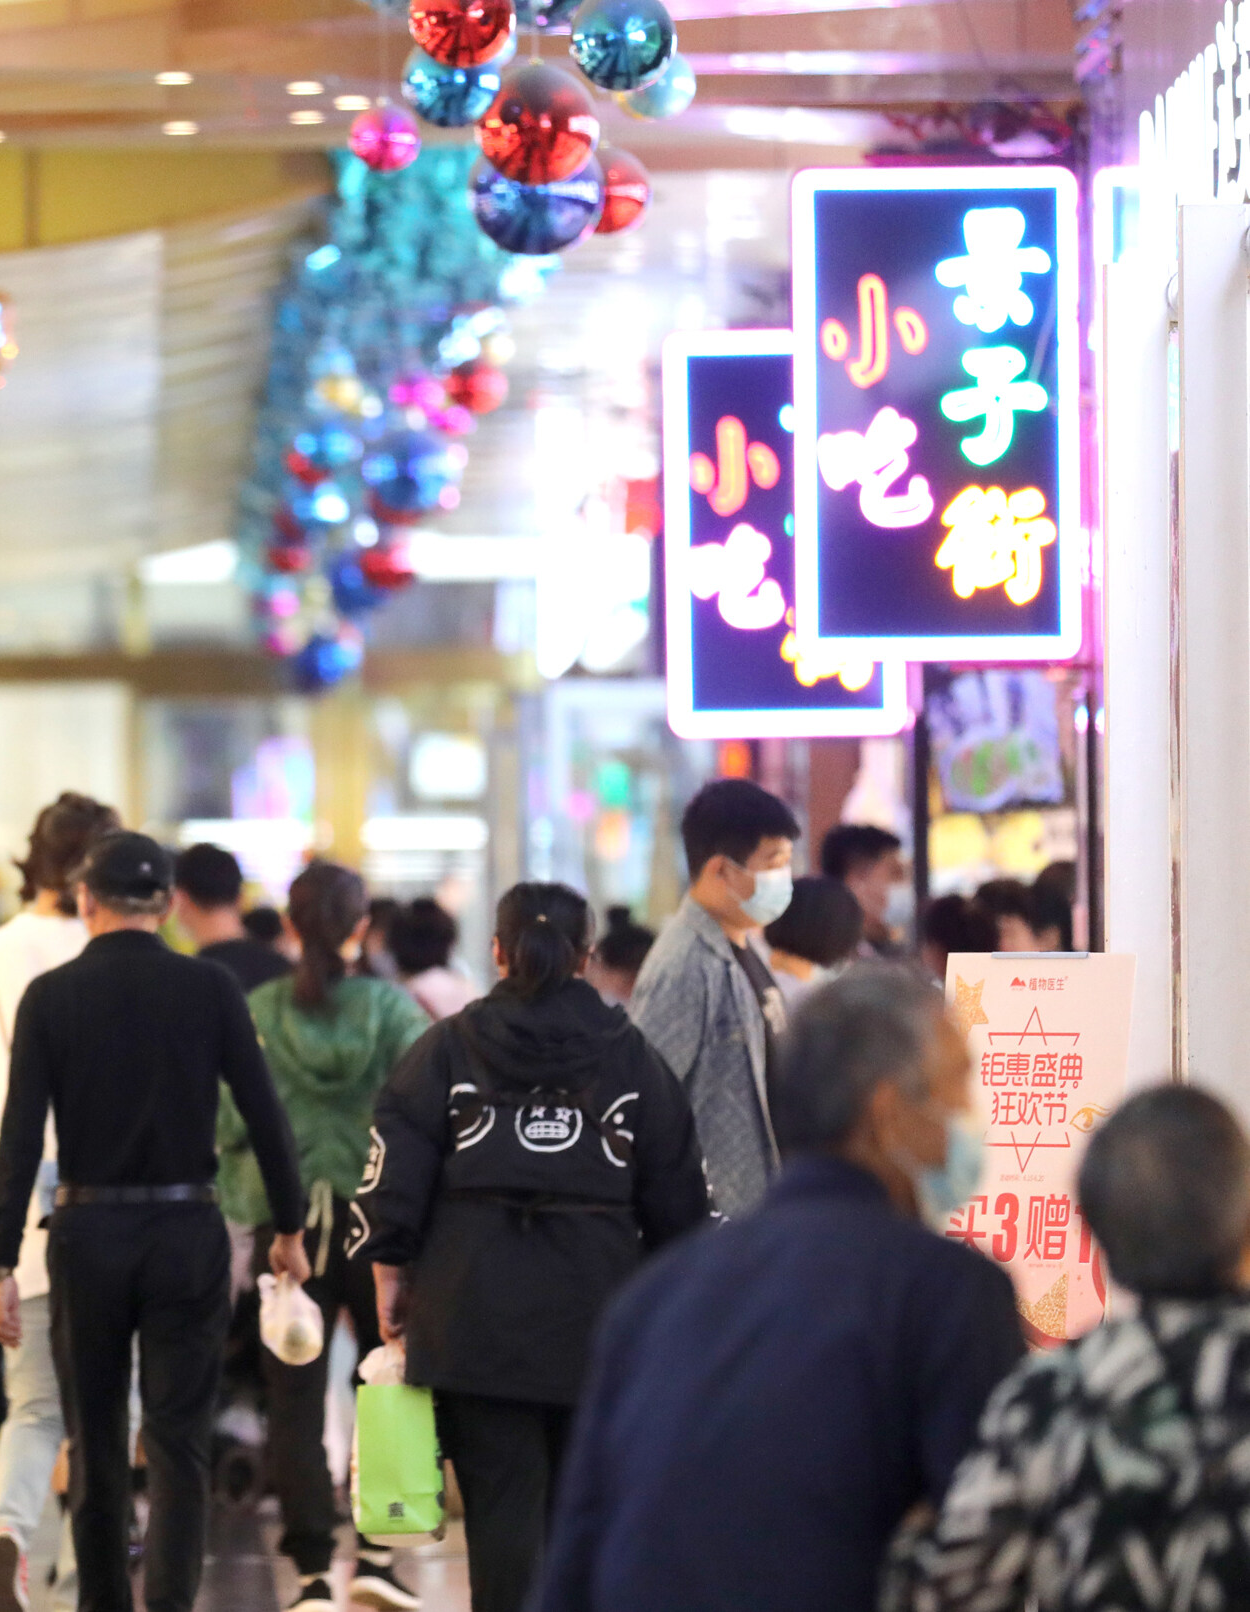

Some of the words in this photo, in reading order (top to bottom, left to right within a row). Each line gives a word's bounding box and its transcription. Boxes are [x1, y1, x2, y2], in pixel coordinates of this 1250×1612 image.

[817, 272, 935, 529] 小吃
[688, 415, 786, 631] 小吃
[1028, 977, 1065, 991] 植物医生
[980, 1051, 1084, 1089] 钜惠盛典
[990, 1091, 1069, 1127] 狂欢节
